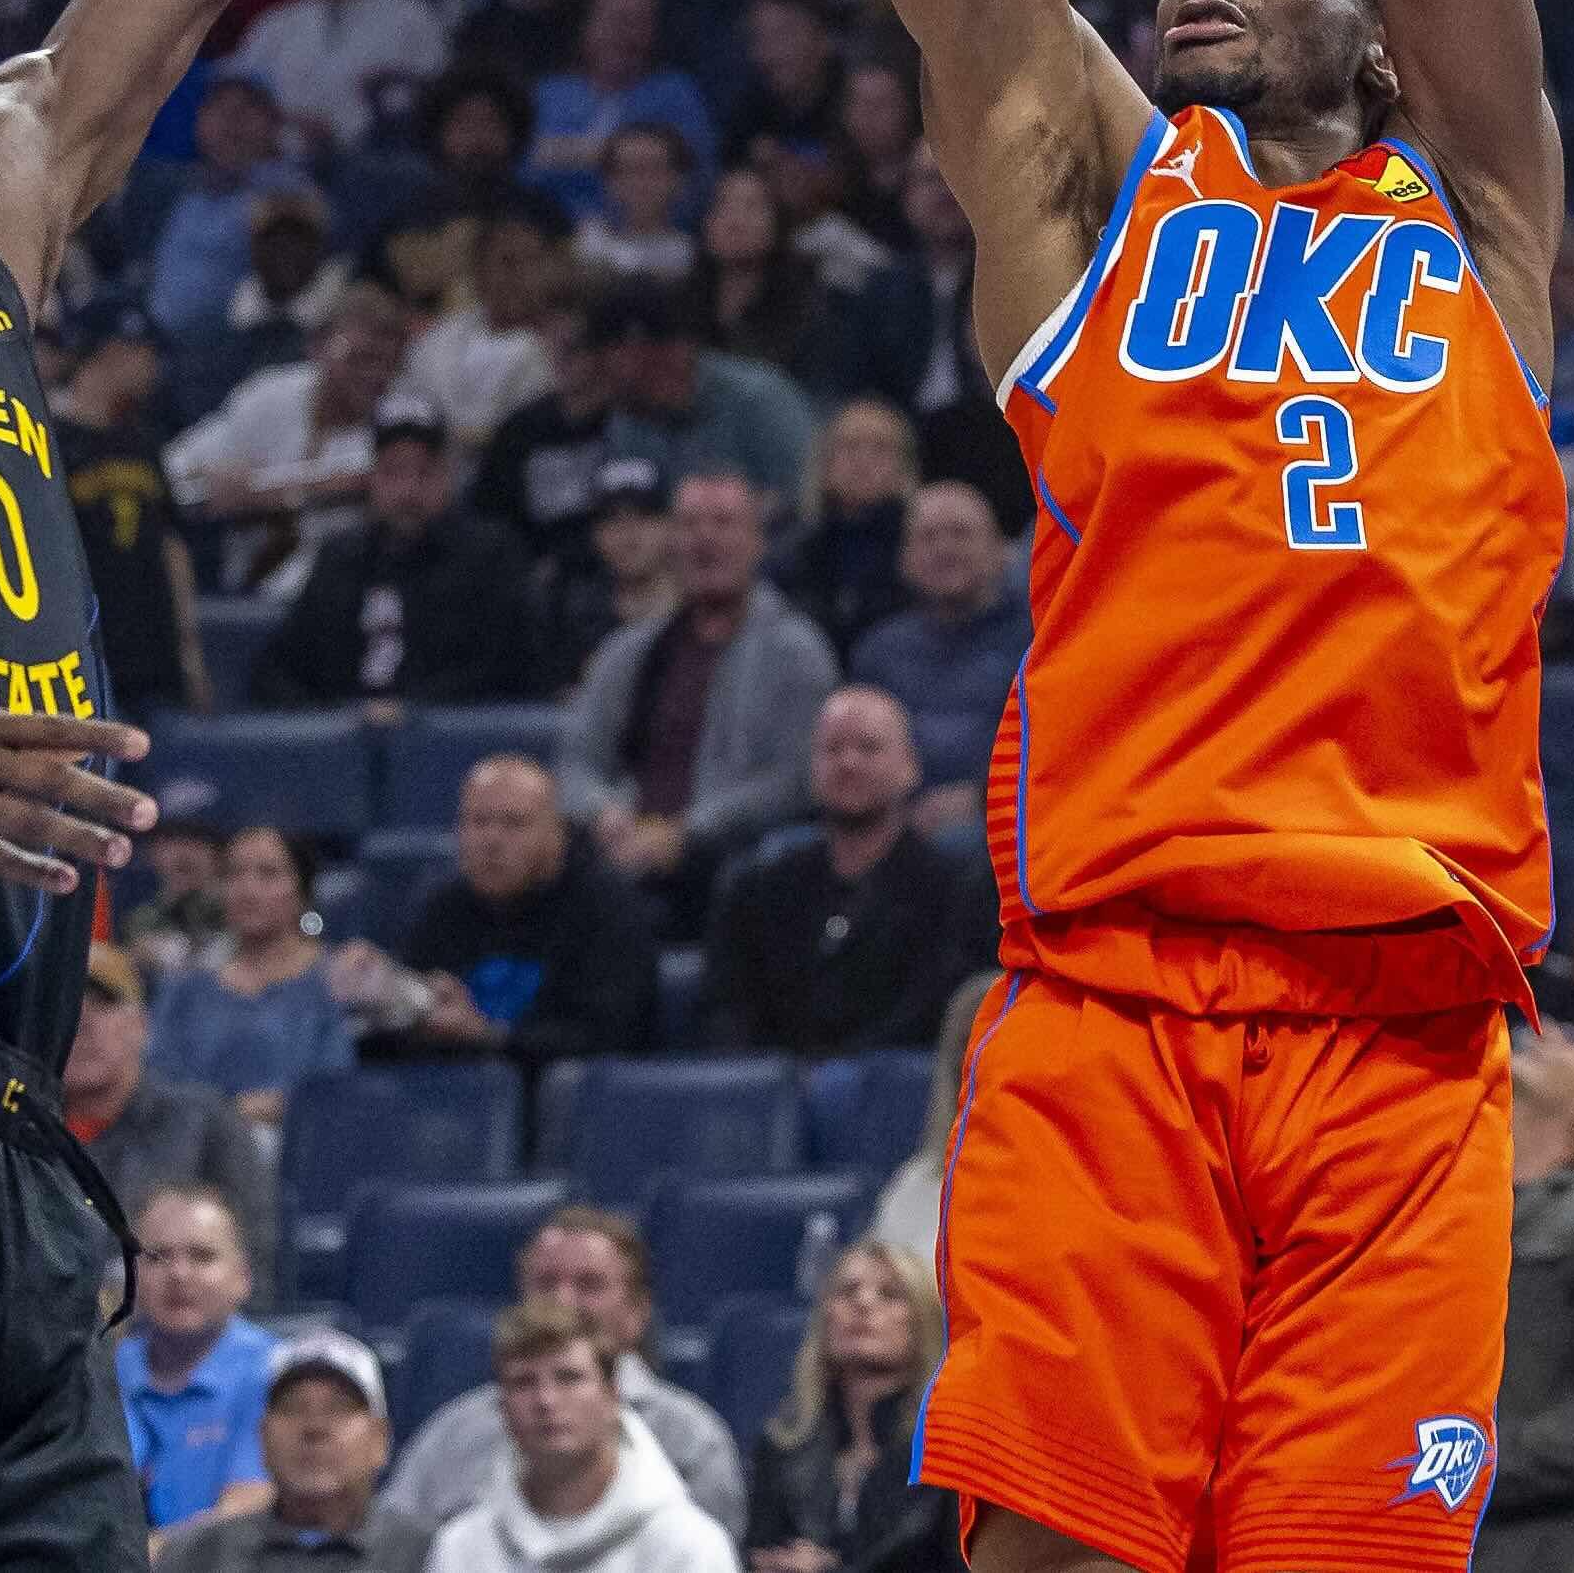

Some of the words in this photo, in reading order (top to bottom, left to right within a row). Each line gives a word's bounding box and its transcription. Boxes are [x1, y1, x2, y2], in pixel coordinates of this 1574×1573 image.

[1118, 198, 1467, 395] OKC
[1275, 393, 1369, 551] 2
[1411, 1439, 1476, 1484] OKC
